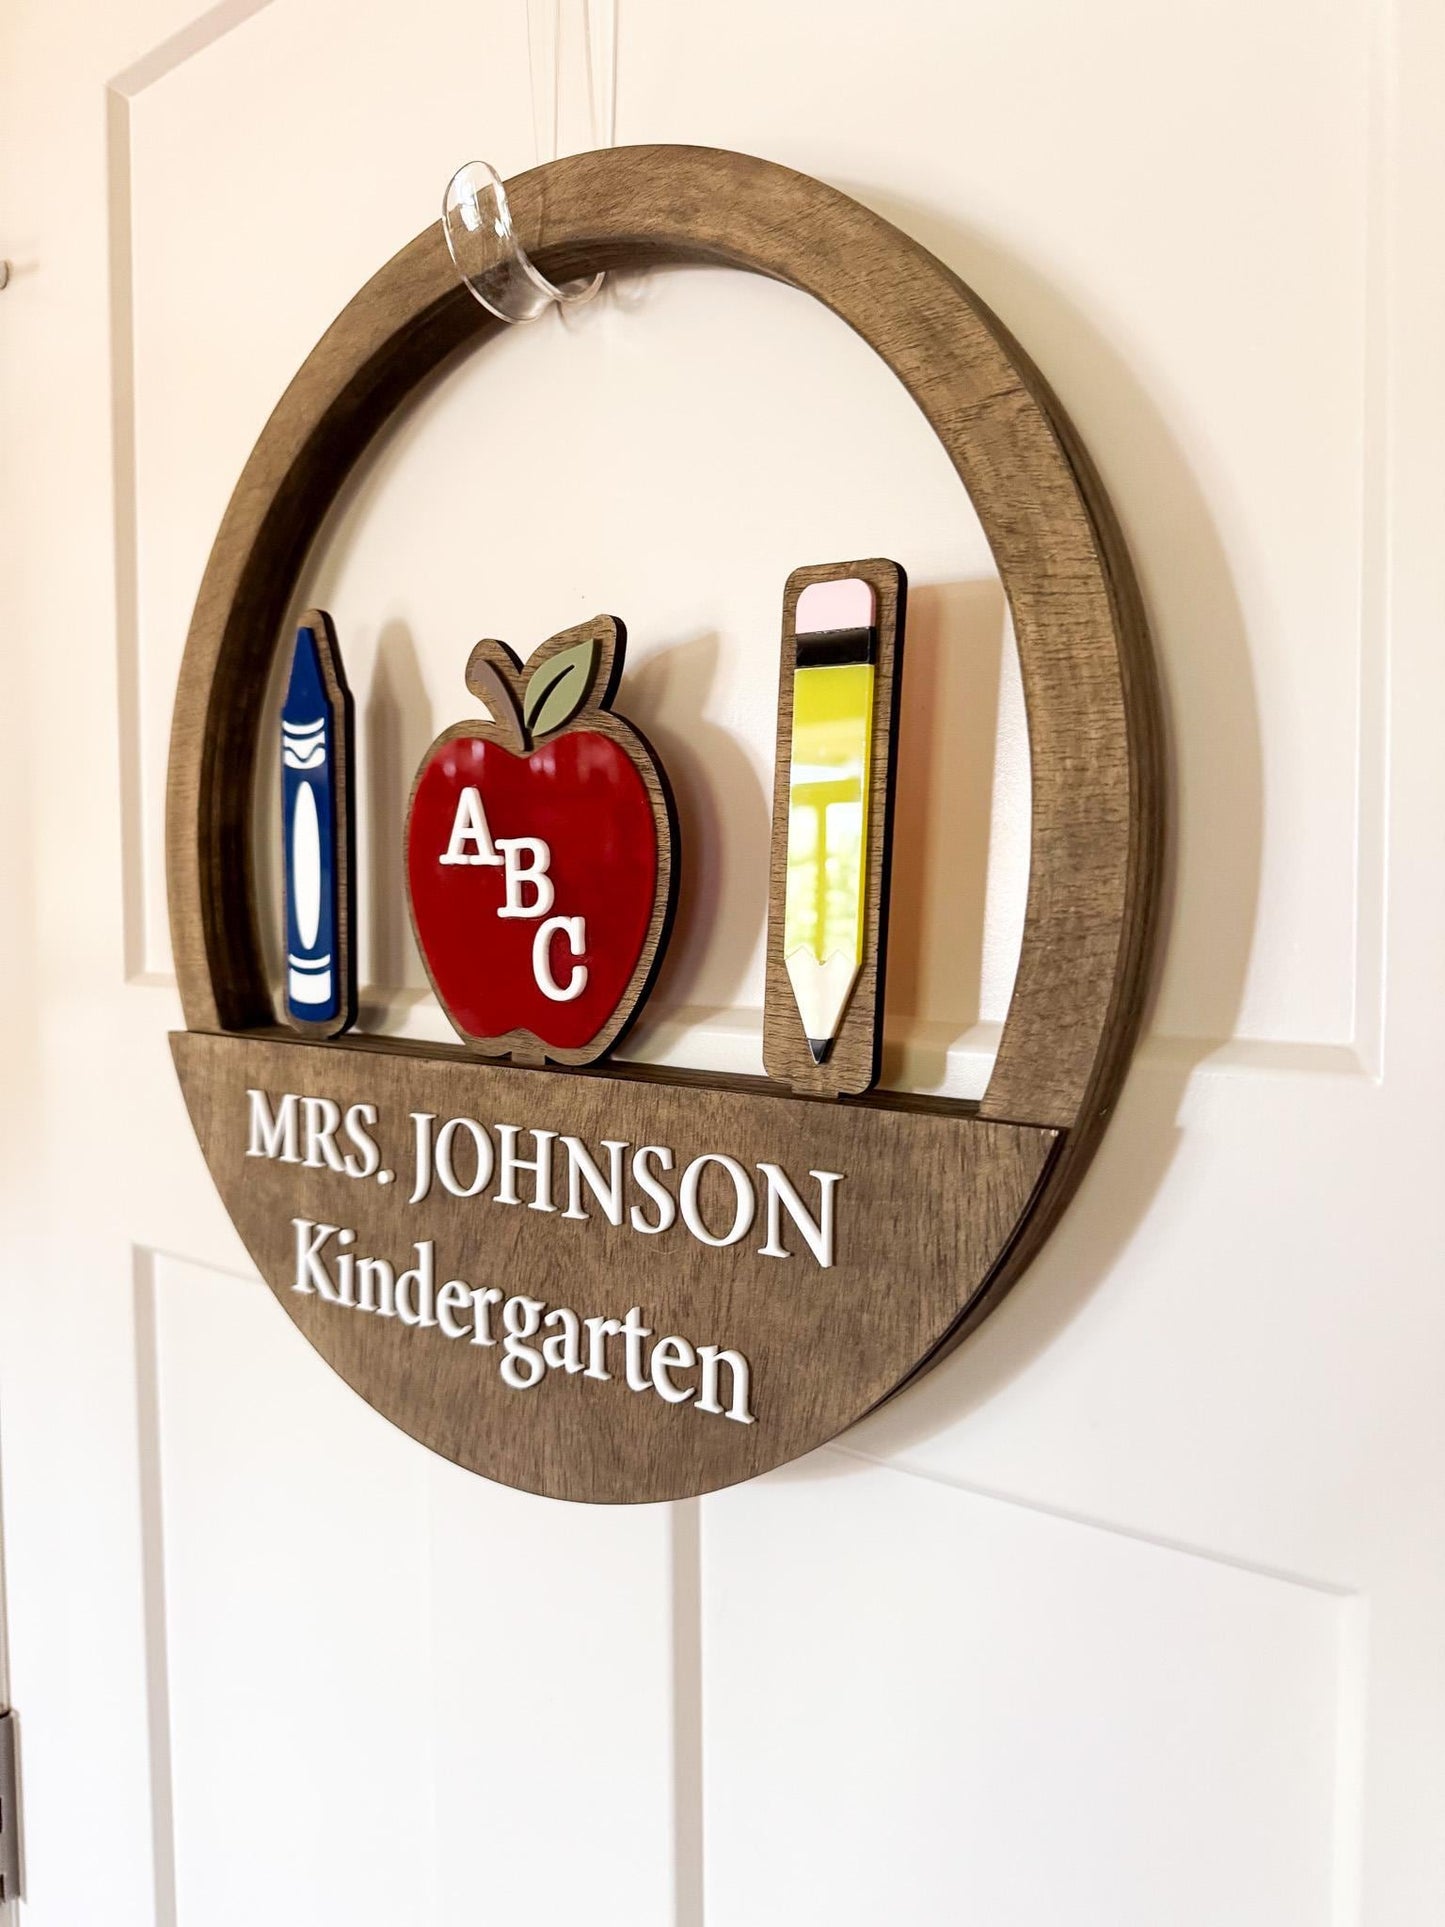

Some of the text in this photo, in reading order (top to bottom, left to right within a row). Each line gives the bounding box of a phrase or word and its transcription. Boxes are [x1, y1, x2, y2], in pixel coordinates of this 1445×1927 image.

[246, 1089, 844, 1268] MRS. JOHNSON
[291, 1218, 756, 1425] Kindergarten
